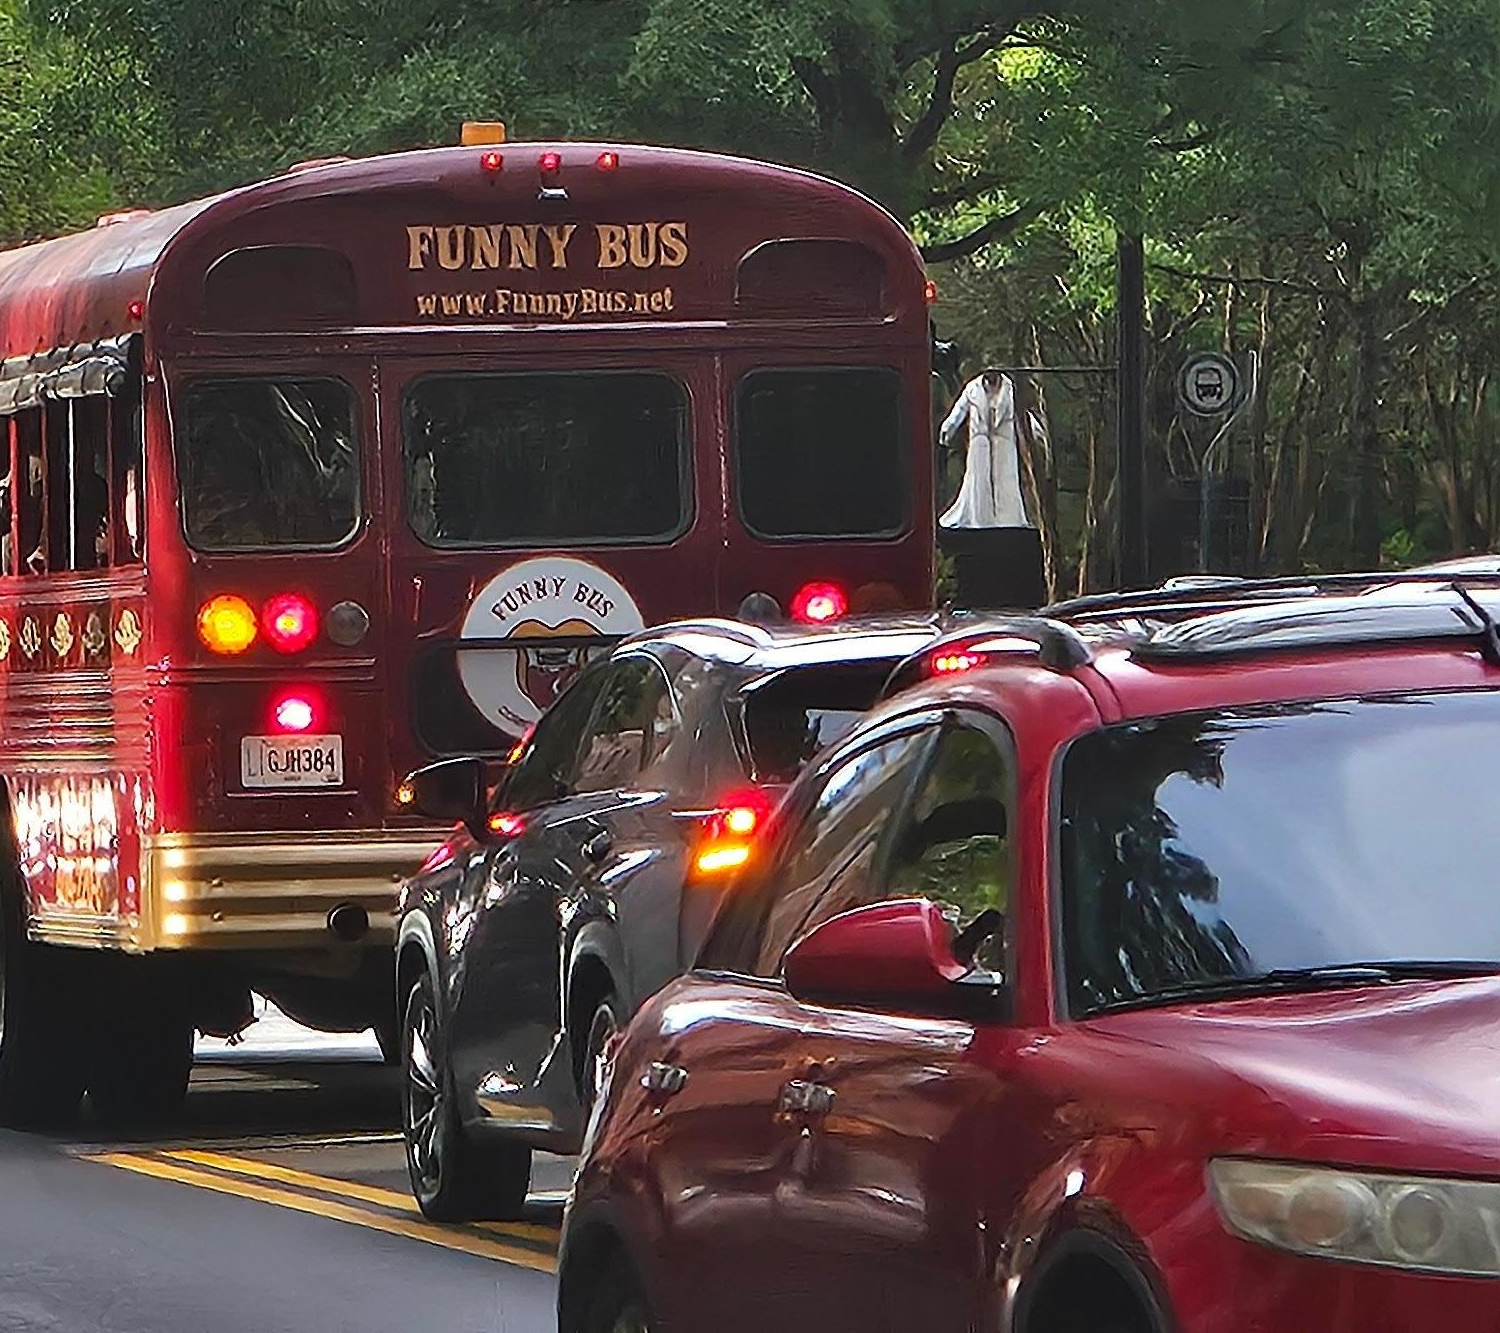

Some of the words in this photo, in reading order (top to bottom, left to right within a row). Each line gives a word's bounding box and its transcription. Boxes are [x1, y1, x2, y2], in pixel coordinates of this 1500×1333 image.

[406, 222, 578, 270] FUNNY
[596, 221, 690, 269] BUS
[416, 286, 675, 320] www.FunnyBus.net
[490, 576, 567, 622] FUNNY
[573, 582, 616, 619] BUS
